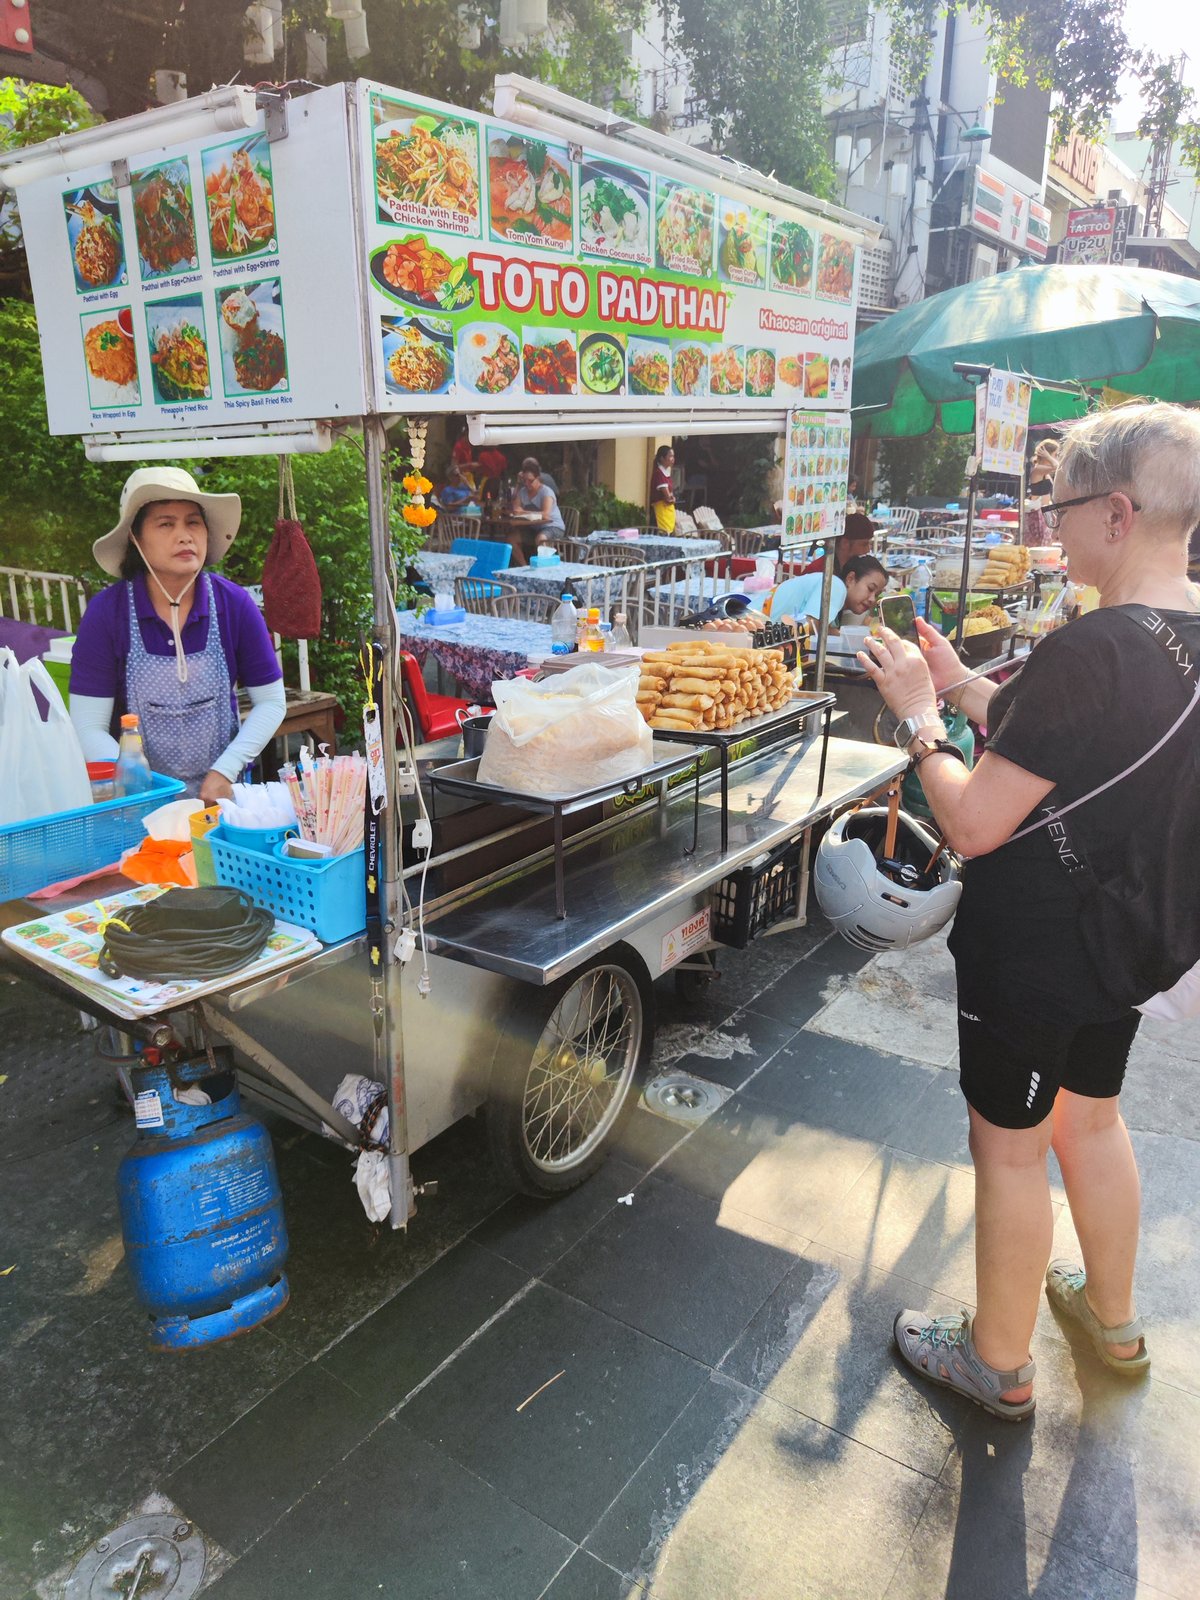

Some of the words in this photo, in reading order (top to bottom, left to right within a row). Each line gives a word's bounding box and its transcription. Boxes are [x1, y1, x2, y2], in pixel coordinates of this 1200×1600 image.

[394, 212, 434, 226] Chicken
[437, 220, 469, 234] Shrimp
[430, 208, 449, 219] with
[452, 211, 469, 224] Egg
[1070, 222, 1111, 233] TATTOO
[1113, 207, 1128, 265] TATTO
[508, 230, 524, 241] Tom
[527, 234, 542, 244] Yom
[545, 237, 564, 249] Kung
[1068, 238, 1105, 252] Up2U
[581, 243, 607, 254] Chicken
[609, 249, 636, 260] Coconut
[637, 253, 652, 263] Soup
[234, 265, 245, 273] with
[246, 259, 280, 272] Egg+Shrimp
[160, 280, 170, 288] with
[470, 254, 588, 317] TOTO
[598, 272, 726, 332] PADTHAI
[110, 290, 118, 298] Egg
[760, 308, 809, 334] Khaosan
[811, 318, 848, 340] original
[236, 400, 249, 408] Spicy
[265, 396, 279, 405] Fried
[281, 395, 292, 403] Rice
[1142, 611, 1194, 676] KYLIE
[368, 821, 376, 871] CHEVROLET
